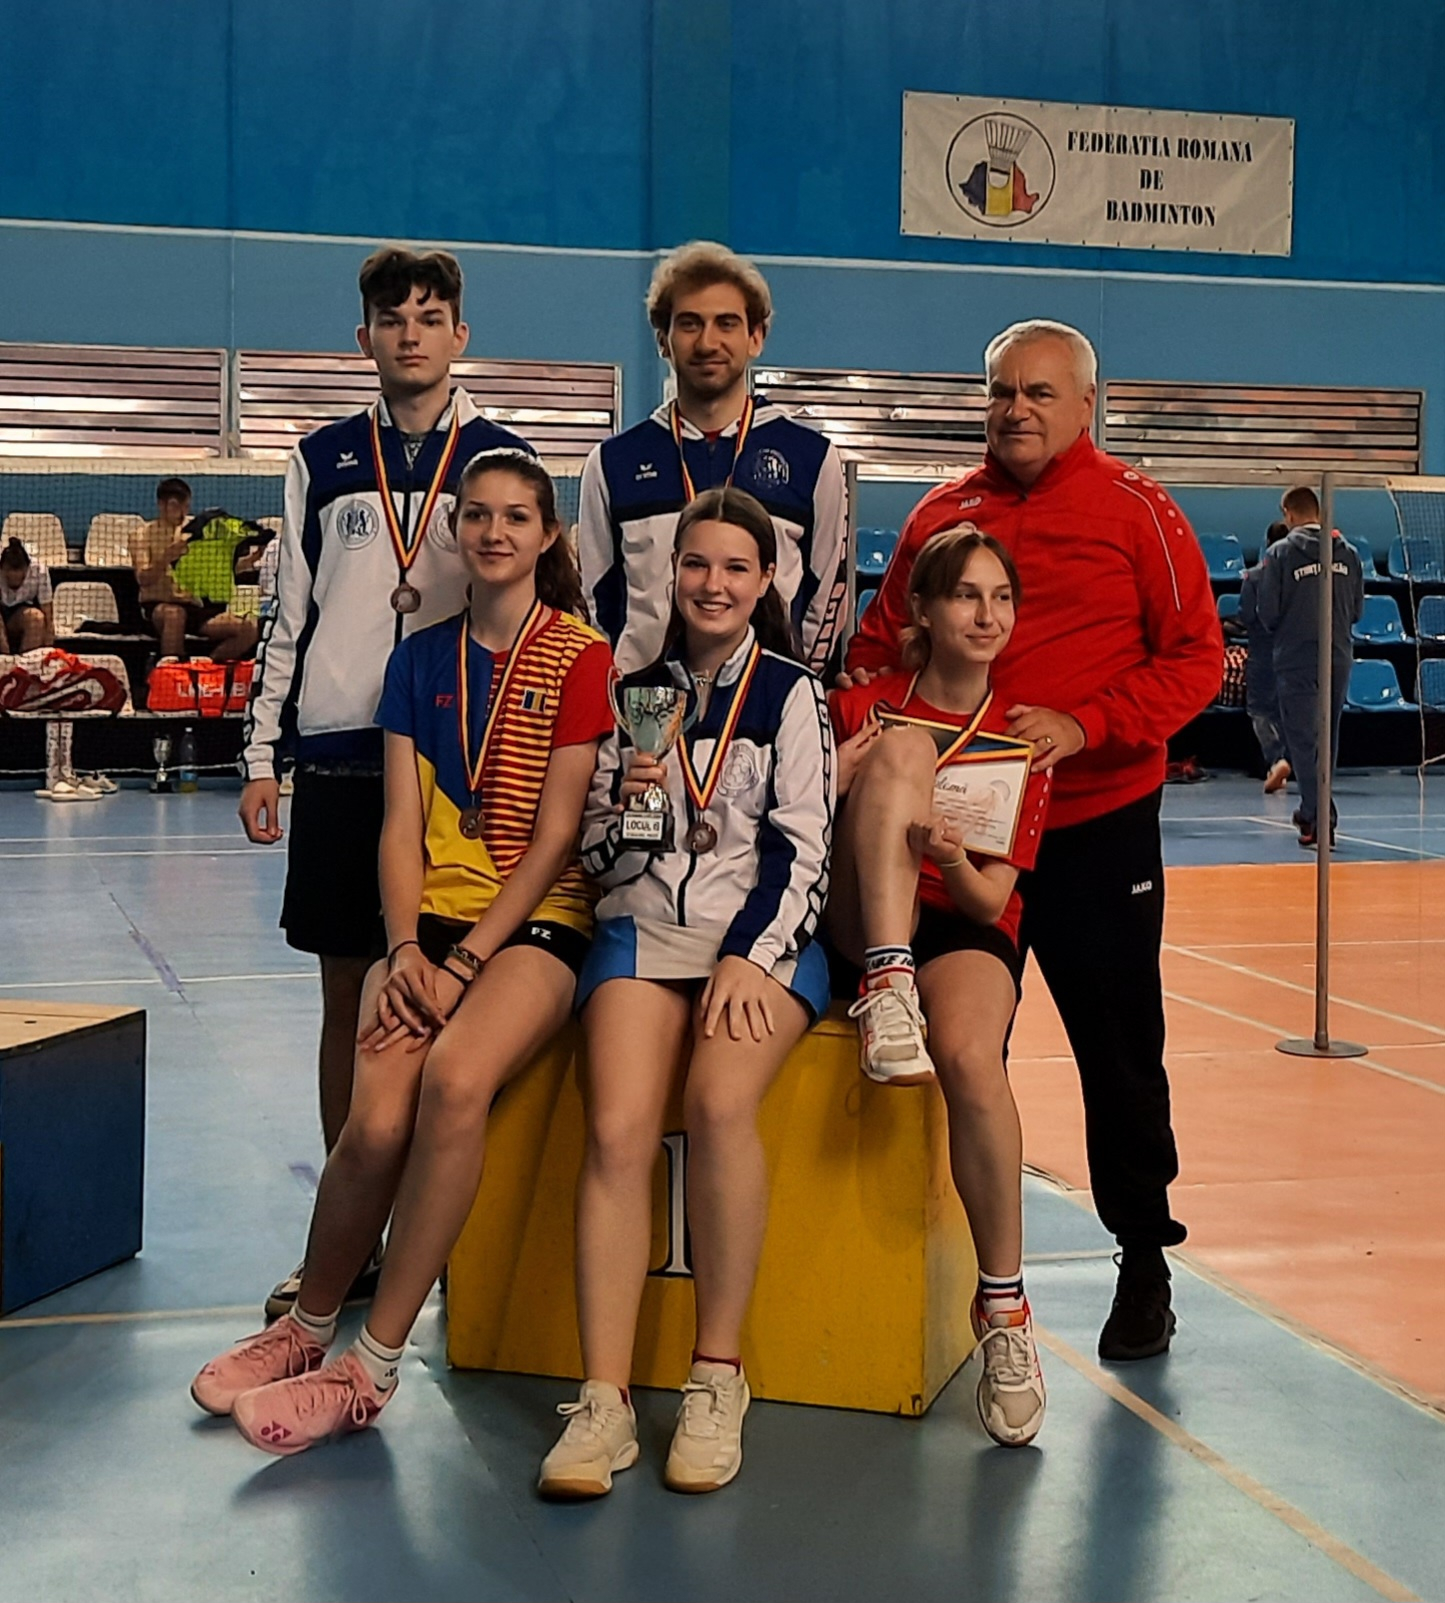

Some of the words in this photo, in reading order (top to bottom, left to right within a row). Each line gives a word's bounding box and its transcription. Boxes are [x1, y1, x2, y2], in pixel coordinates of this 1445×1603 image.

[1067, 130, 1170, 158] FEDERATIA
[1177, 138, 1252, 163] ROMANA
[1140, 168, 1164, 191] DE
[1106, 199, 1216, 227] BADMINTON
